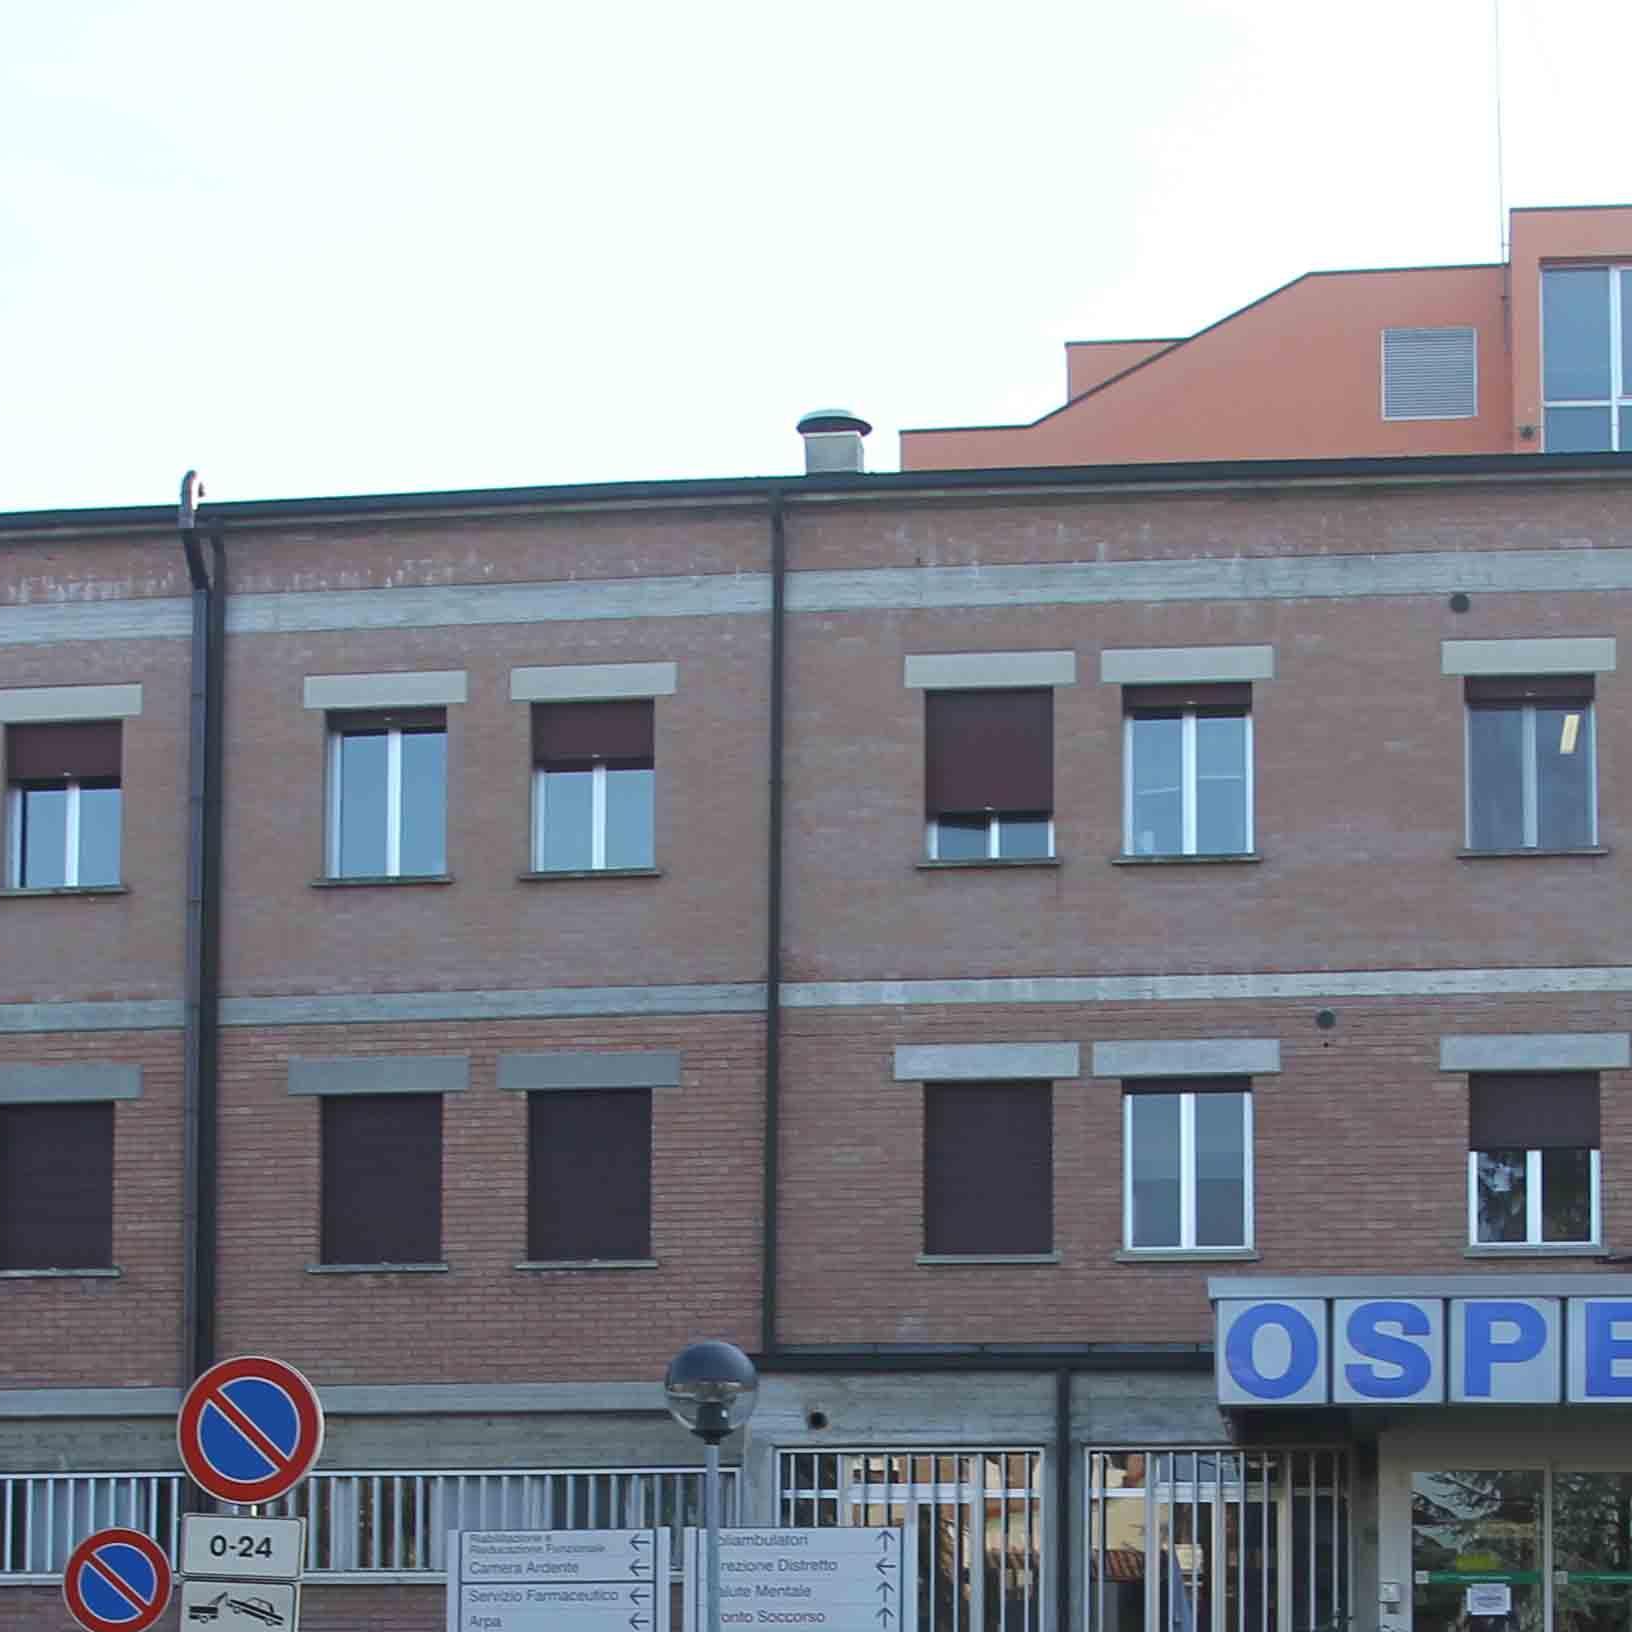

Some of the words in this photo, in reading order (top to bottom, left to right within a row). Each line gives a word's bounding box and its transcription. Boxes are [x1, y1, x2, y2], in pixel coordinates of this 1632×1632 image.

[209, 1534, 274, 1559] 0-24
[718, 1534, 808, 1547] oliambulatori
[470, 1561, 522, 1574] Camera
[526, 1560, 578, 1574] Ardente
[720, 1561, 773, 1572] rezione
[777, 1558, 839, 1572] Distretto
[469, 1590, 522, 1602] Servizio
[527, 1589, 619, 1601] Farmaceutico
[719, 1585, 752, 1598] alute
[754, 1584, 813, 1598] Mentale
[470, 1615, 503, 1630] Arpa
[720, 1611, 754, 1623] onto
[757, 1610, 826, 1623] Soccorso
